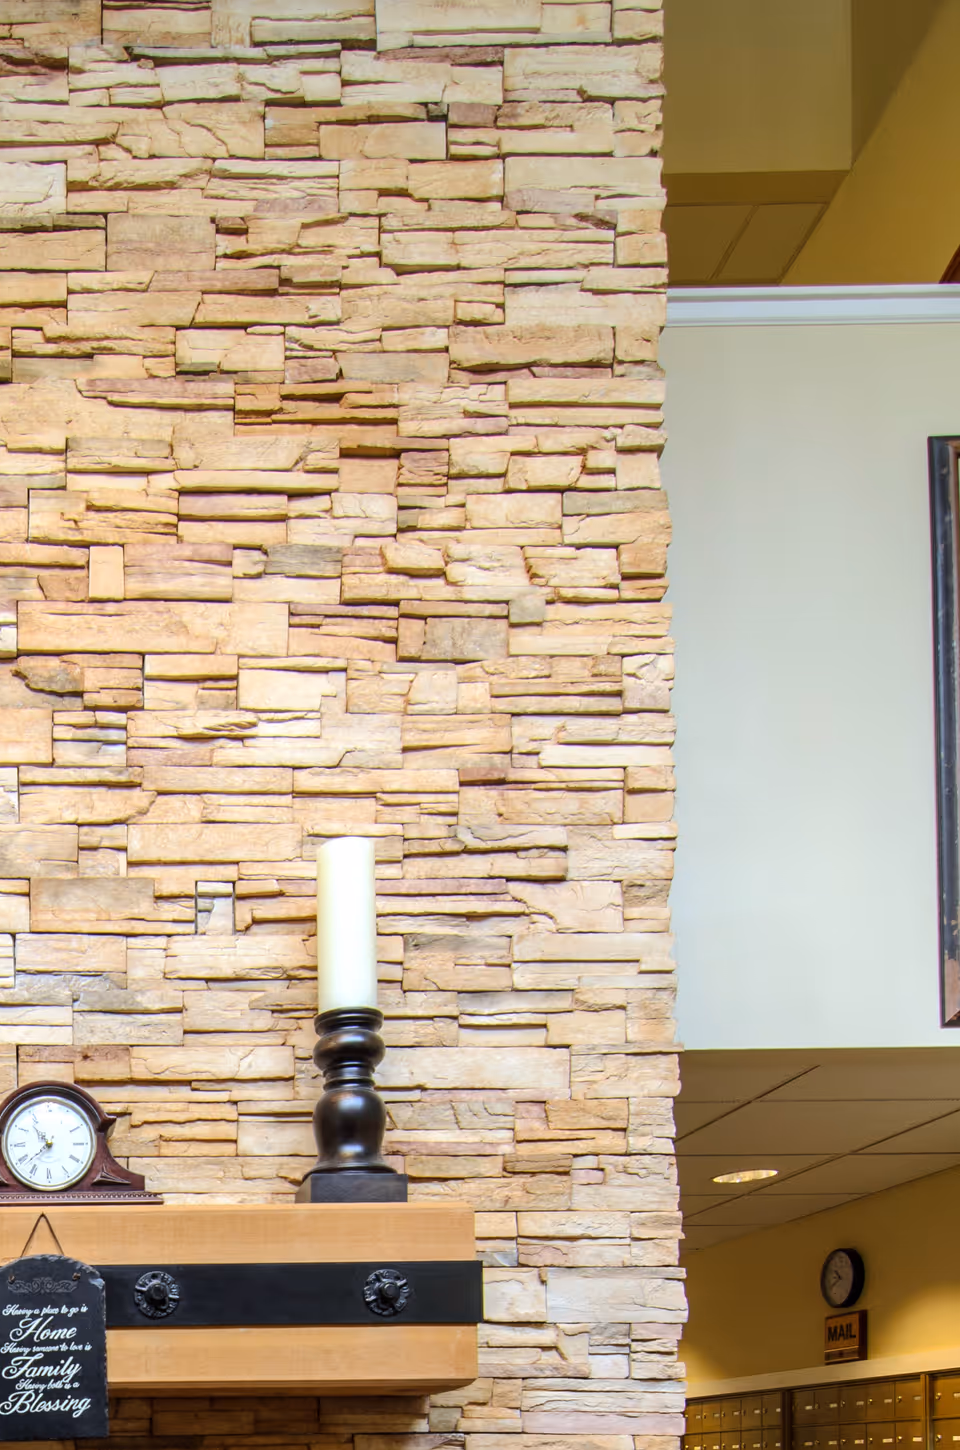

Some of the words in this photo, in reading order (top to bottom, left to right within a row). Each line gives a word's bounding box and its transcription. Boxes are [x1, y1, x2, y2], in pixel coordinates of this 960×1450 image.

[60, 1304, 68, 1314] to
[68, 1307, 79, 1317] go
[80, 1303, 88, 1312] is
[9, 1315, 77, 1342] Home
[827, 1323, 856, 1342] MAIL
[84, 1342, 92, 1350] is
[1, 1352, 82, 1383] Family
